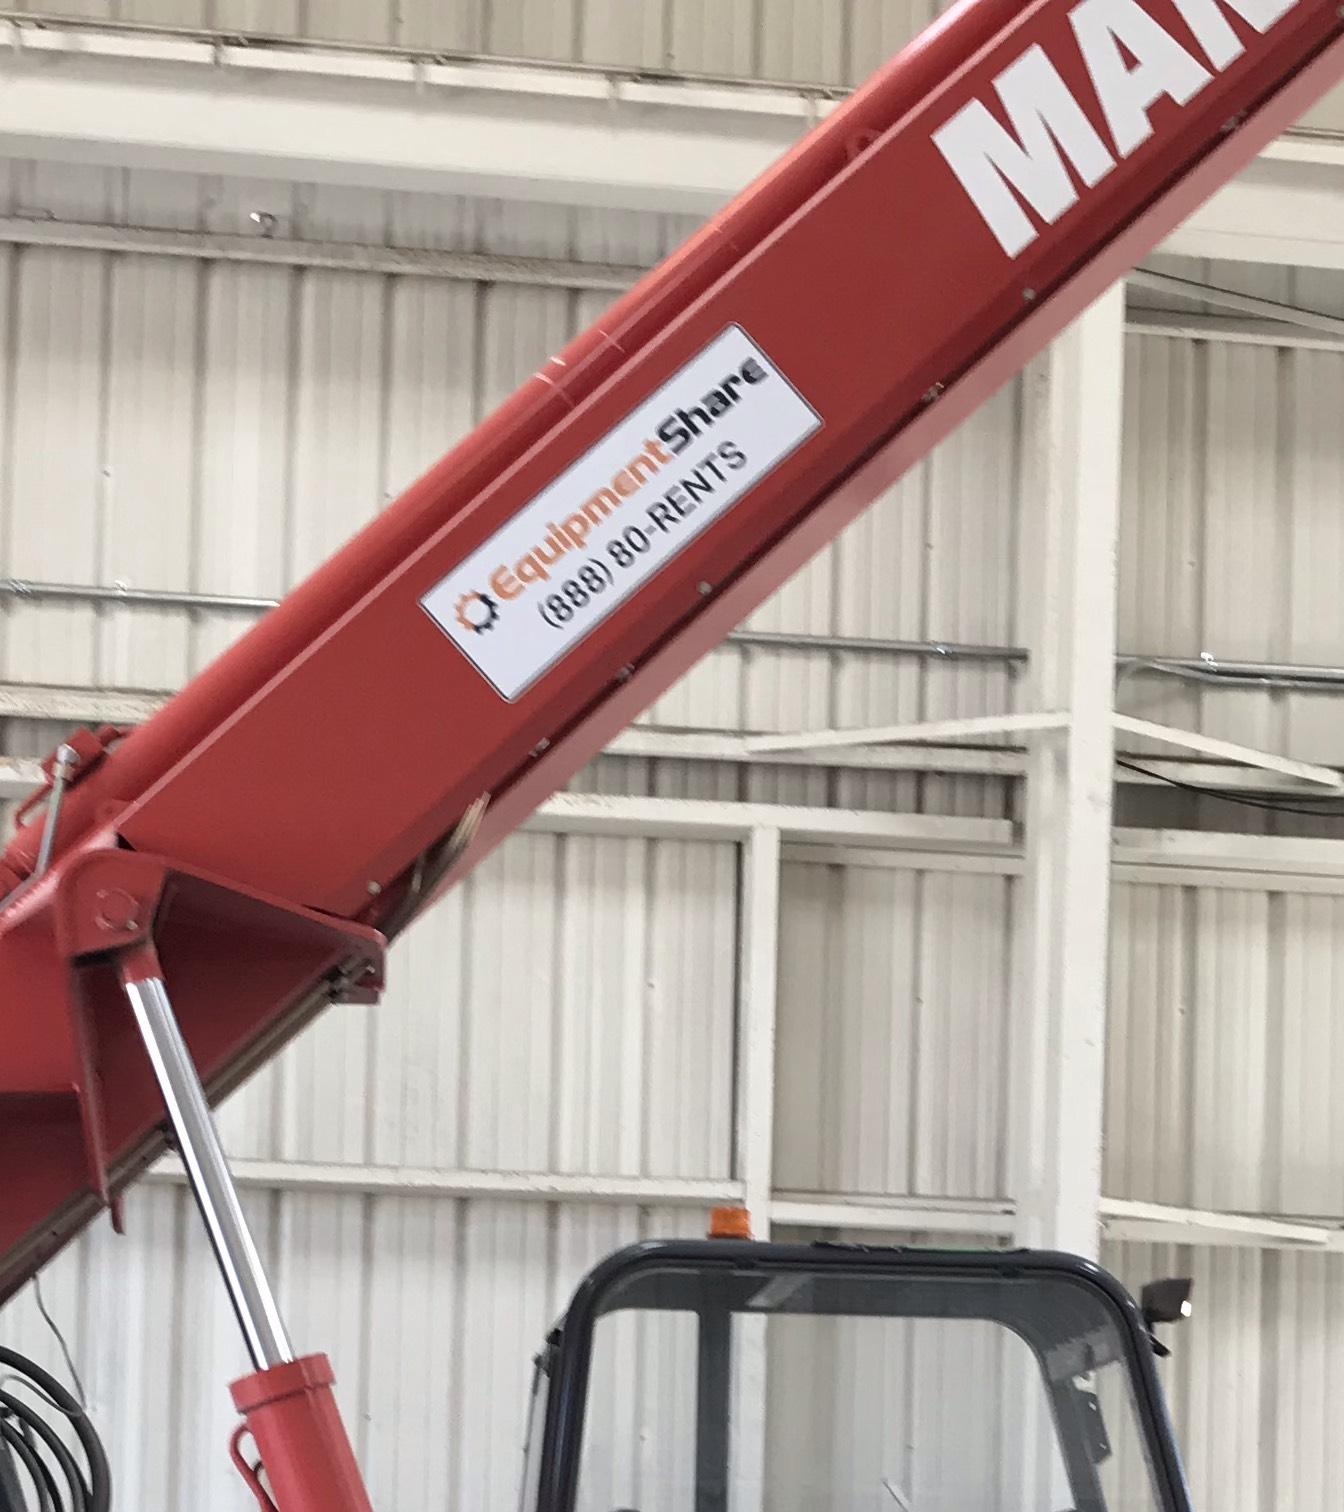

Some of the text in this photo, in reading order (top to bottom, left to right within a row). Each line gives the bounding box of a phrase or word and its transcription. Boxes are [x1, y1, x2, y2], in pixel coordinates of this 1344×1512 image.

[488, 357, 770, 602] EquipmentShare
[538, 440, 747, 630] (888) 80-RENTS
